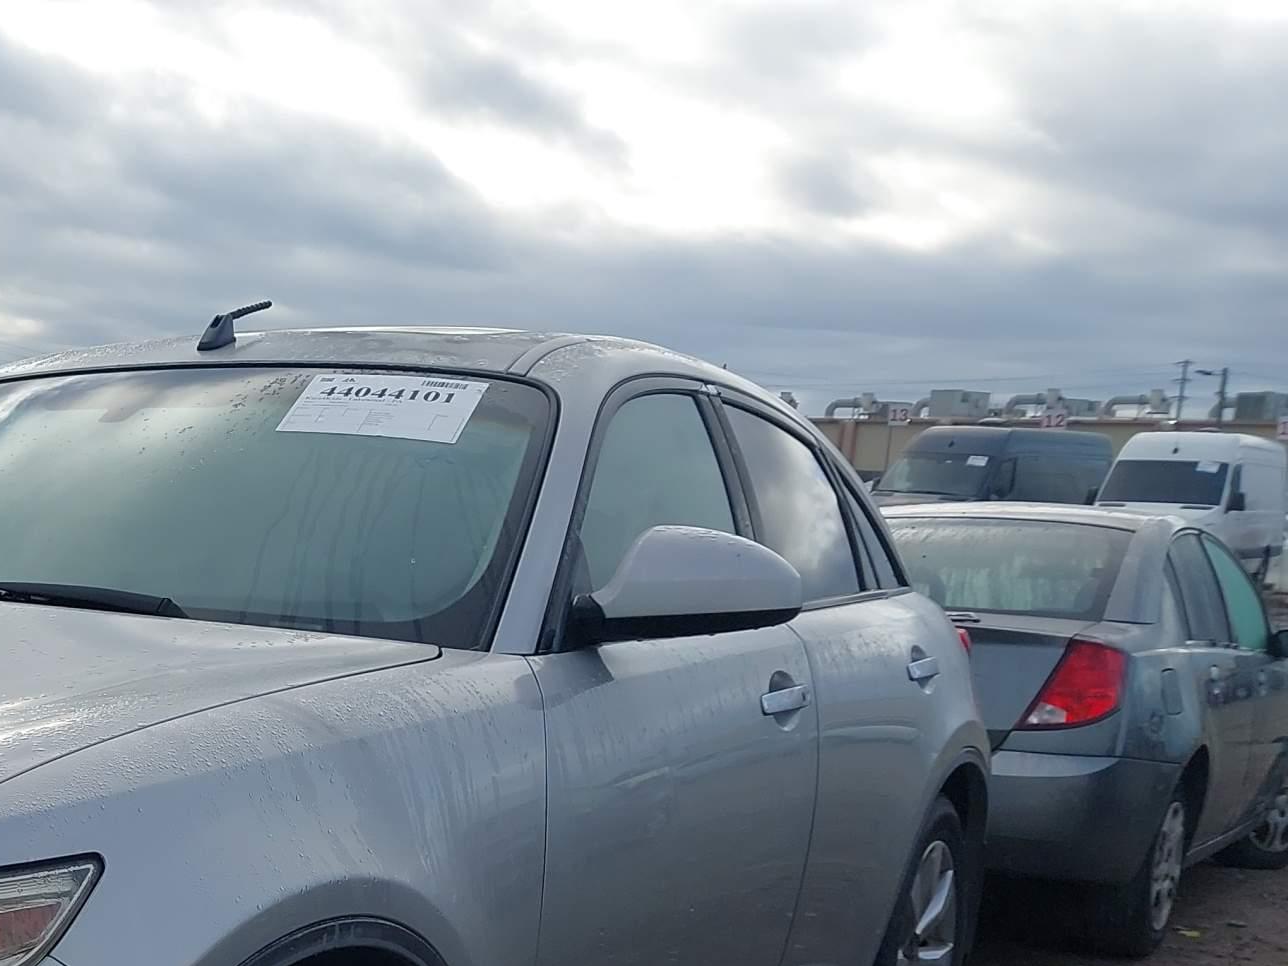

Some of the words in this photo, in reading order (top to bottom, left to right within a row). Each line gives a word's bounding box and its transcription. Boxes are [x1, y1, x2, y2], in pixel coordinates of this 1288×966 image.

[320, 385, 456, 404] 44044101
[890, 408, 909, 422] 13
[1045, 413, 1065, 428] 12
